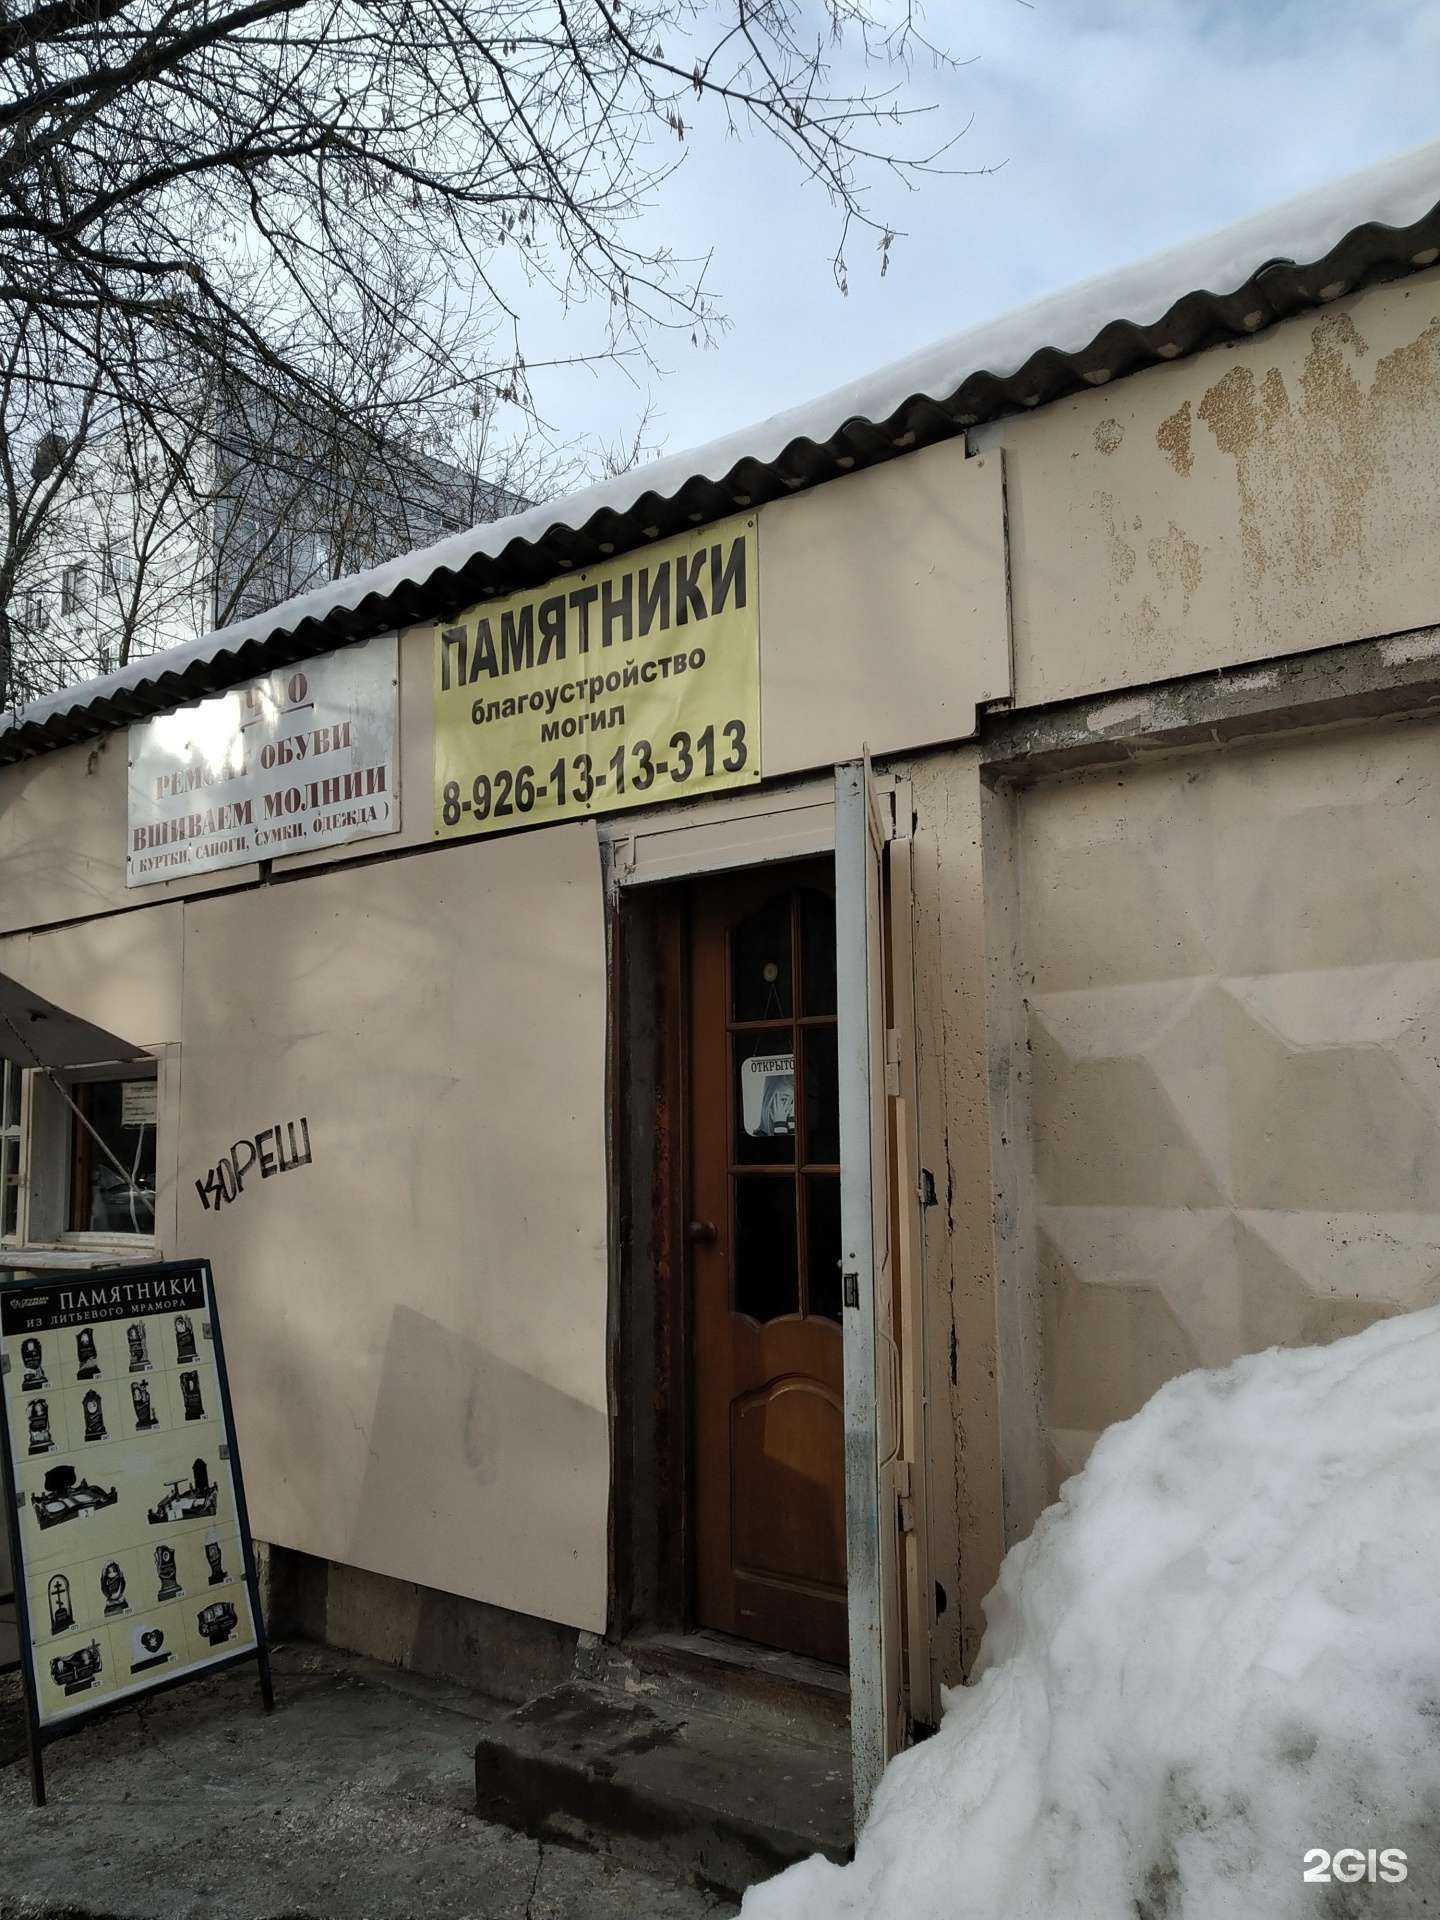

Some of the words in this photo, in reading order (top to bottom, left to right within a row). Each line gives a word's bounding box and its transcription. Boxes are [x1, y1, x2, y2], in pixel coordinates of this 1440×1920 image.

[441, 536, 746, 691] ПАМЯТНИКИ
[471, 647, 706, 725] благоустройство
[541, 704, 625, 743] могил
[260, 721, 353, 769] ОБУВИ
[443, 719, 748, 826] 8-926-13-13-313
[132, 799, 254, 852] ВШИВАЕМ
[264, 766, 387, 819] МОЛНИИ
[194, 1117, 313, 1211] КОРЕШ
[26, 1318, 43, 1329] ИЗ
[50, 1306, 124, 1326] ЛИТЬЕВОГО
[131, 1298, 187, 1313] МРАМОРА
[60, 1278, 197, 1310] ПАМЯТНИКИ
